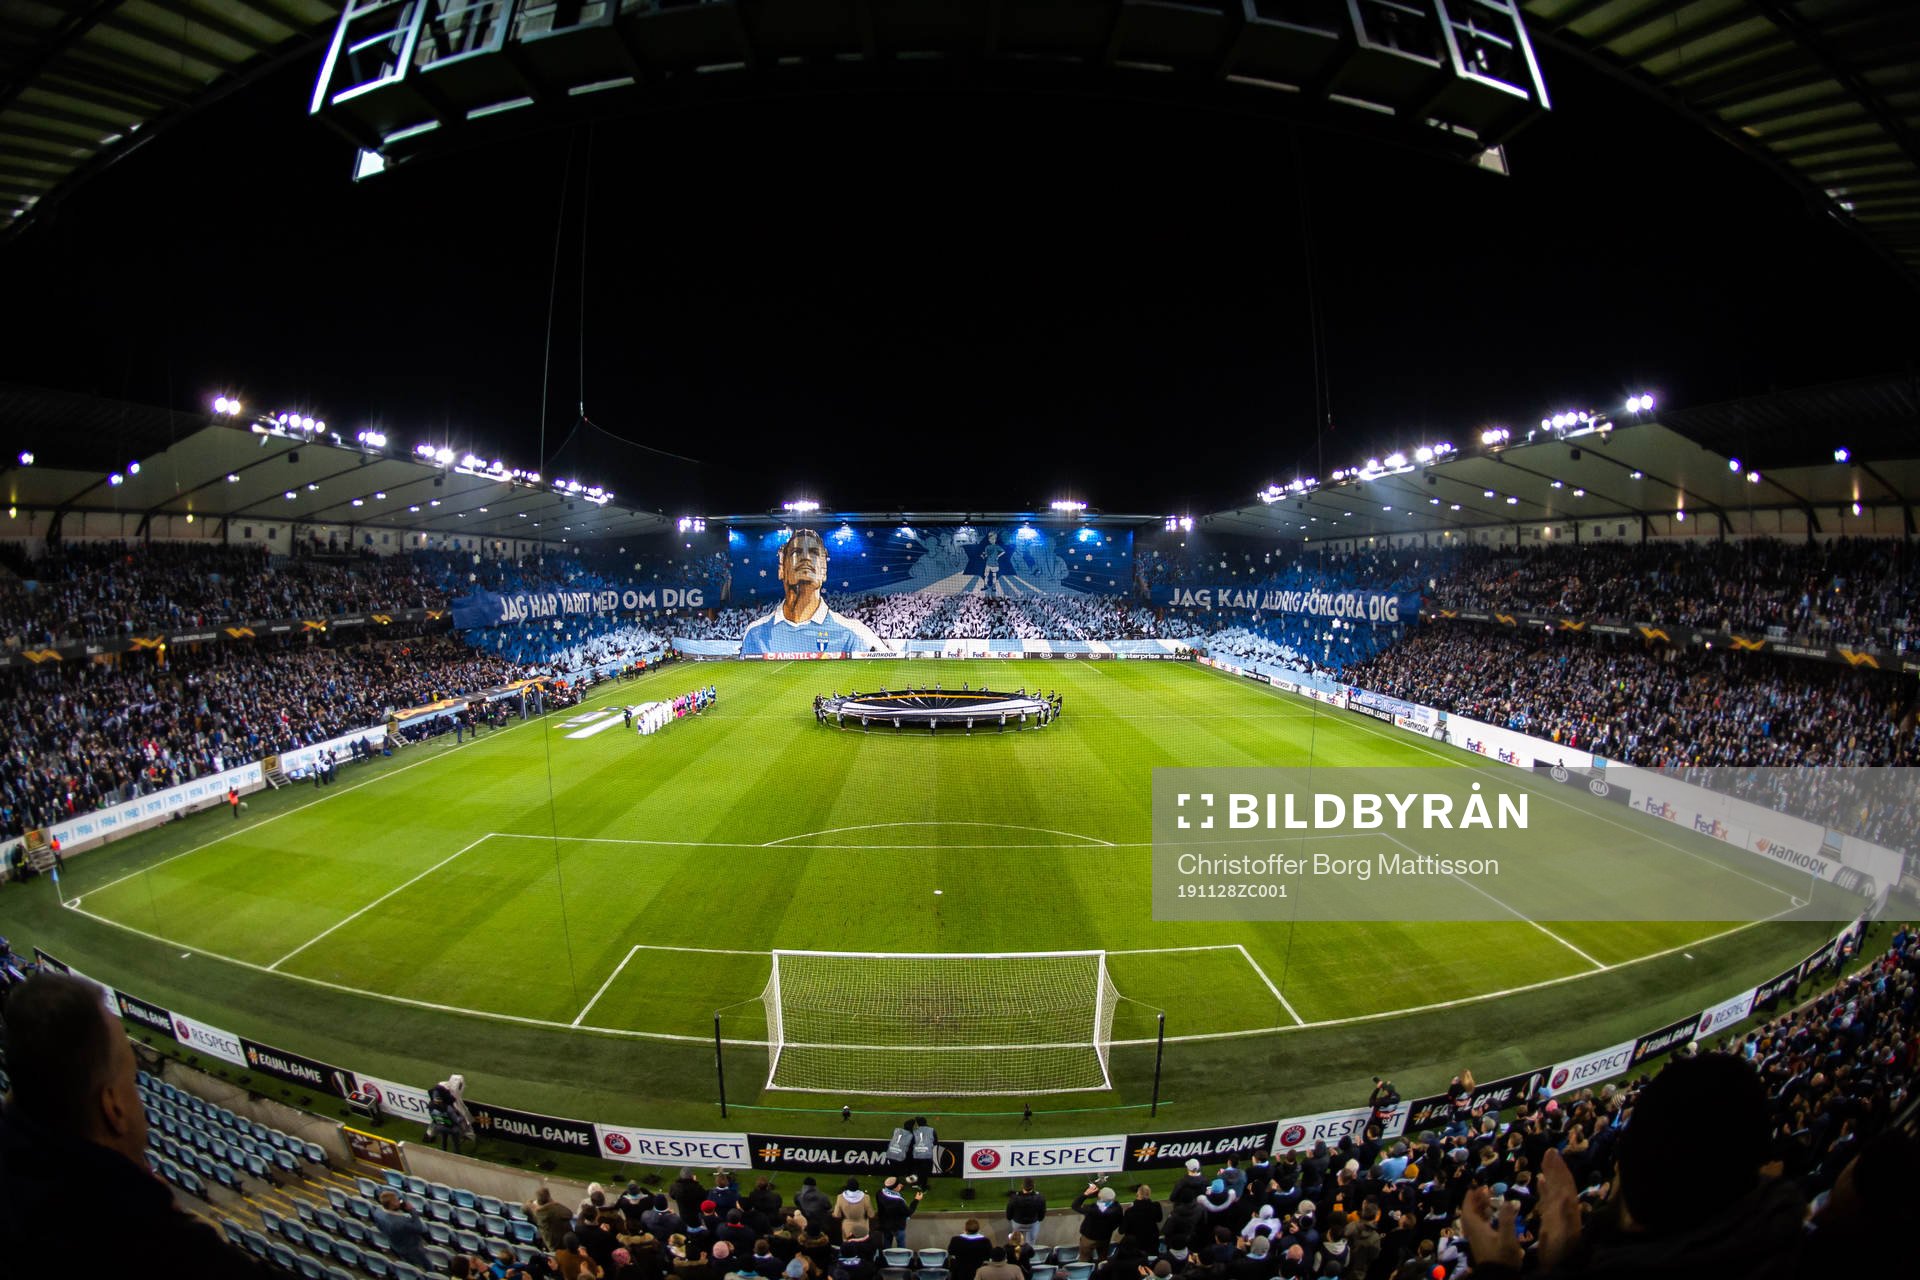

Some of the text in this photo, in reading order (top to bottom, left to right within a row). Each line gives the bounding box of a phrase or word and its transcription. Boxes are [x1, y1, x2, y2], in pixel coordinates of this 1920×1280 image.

[501, 588, 704, 621] JAG HAR VARIT MED OM DIG
[1168, 587, 1399, 622] JAG KAN ALDRIG FÖRLORA DIG
[1467, 738, 1487, 755] FedEx
[1498, 748, 1520, 766] FedEx
[1646, 797, 1676, 821] FedEx
[1694, 814, 1728, 840] FedEx
[191, 1027, 241, 1057] RESPECT
[1572, 1051, 1631, 1081] RESPECT
[387, 1091, 430, 1114] RESP
[1313, 1113, 1406, 1140] RESPT
[639, 1139, 744, 1160] RESPECT
[1010, 1146, 1121, 1167] RESPECT
